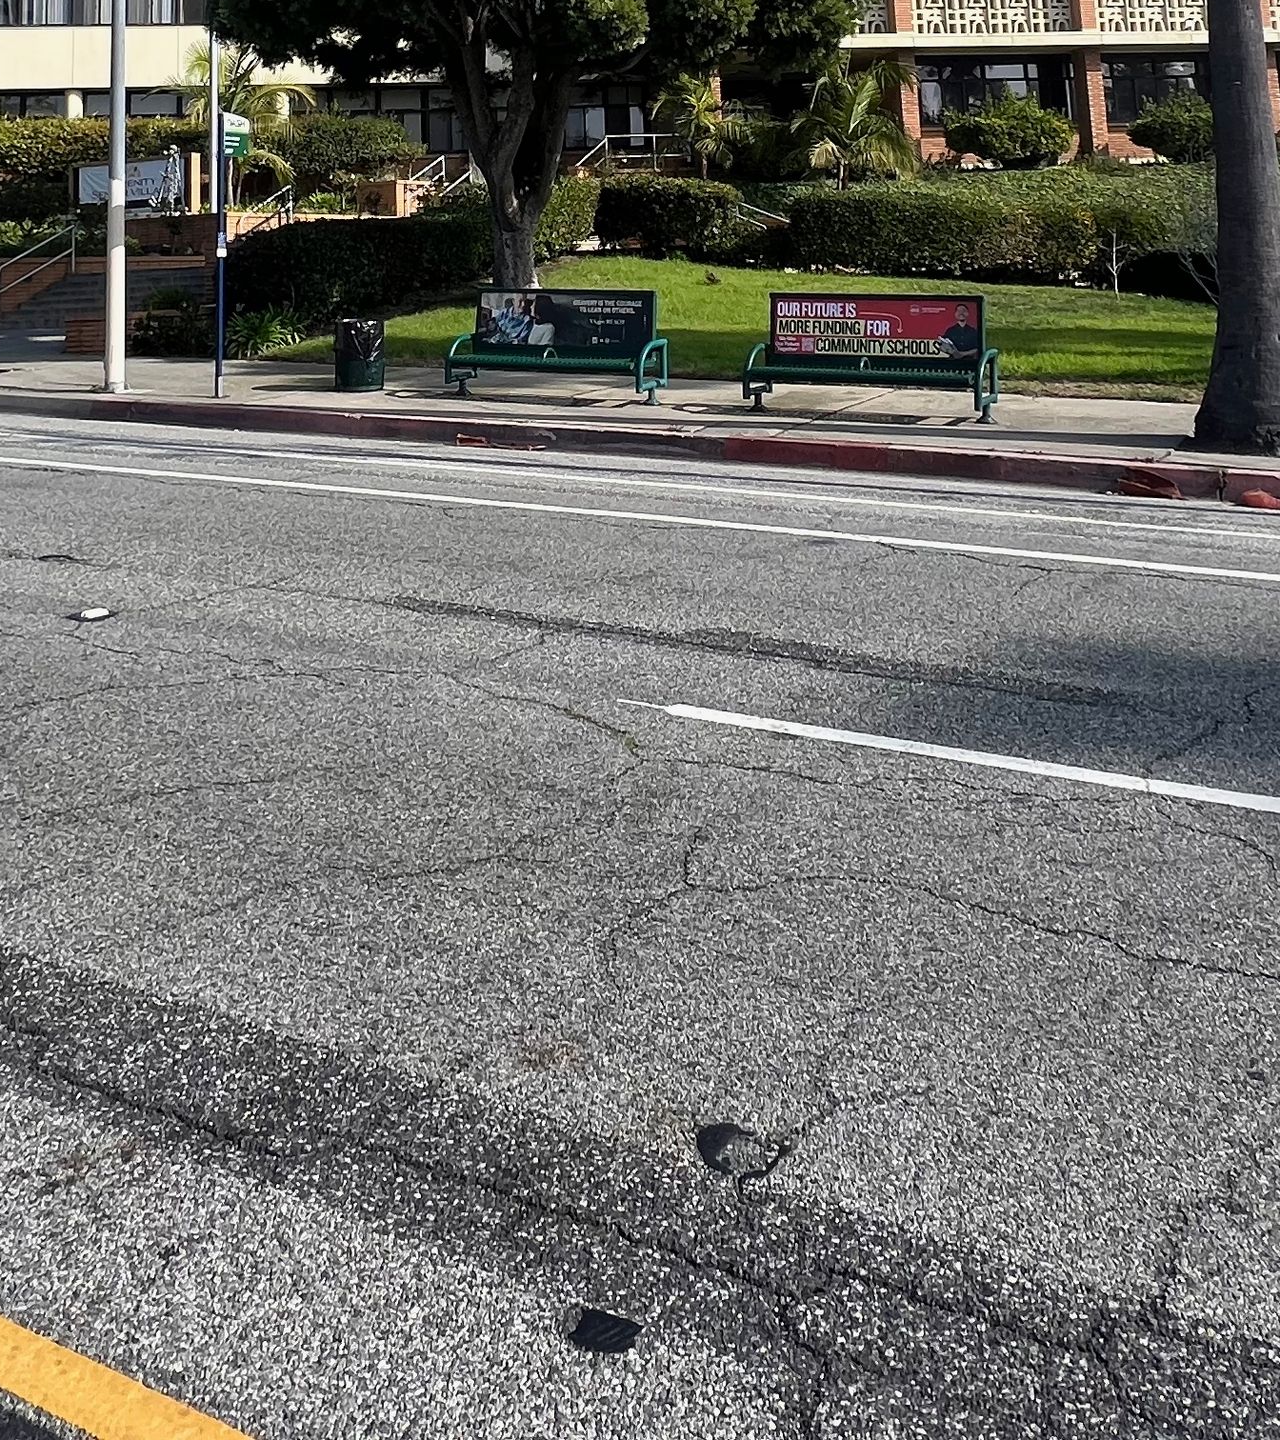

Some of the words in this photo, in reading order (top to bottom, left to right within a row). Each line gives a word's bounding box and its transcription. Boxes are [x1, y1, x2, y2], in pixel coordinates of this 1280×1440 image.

[777, 301, 801, 317] OUR
[801, 302, 844, 317] FUTURE
[845, 302, 857, 318] IS
[778, 319, 811, 334] MORE
[812, 320, 861, 335] FUNDING
[866, 320, 890, 336] FOR
[816, 338, 885, 354] COMMUNITY
[887, 339, 941, 356] SCHOOLS
